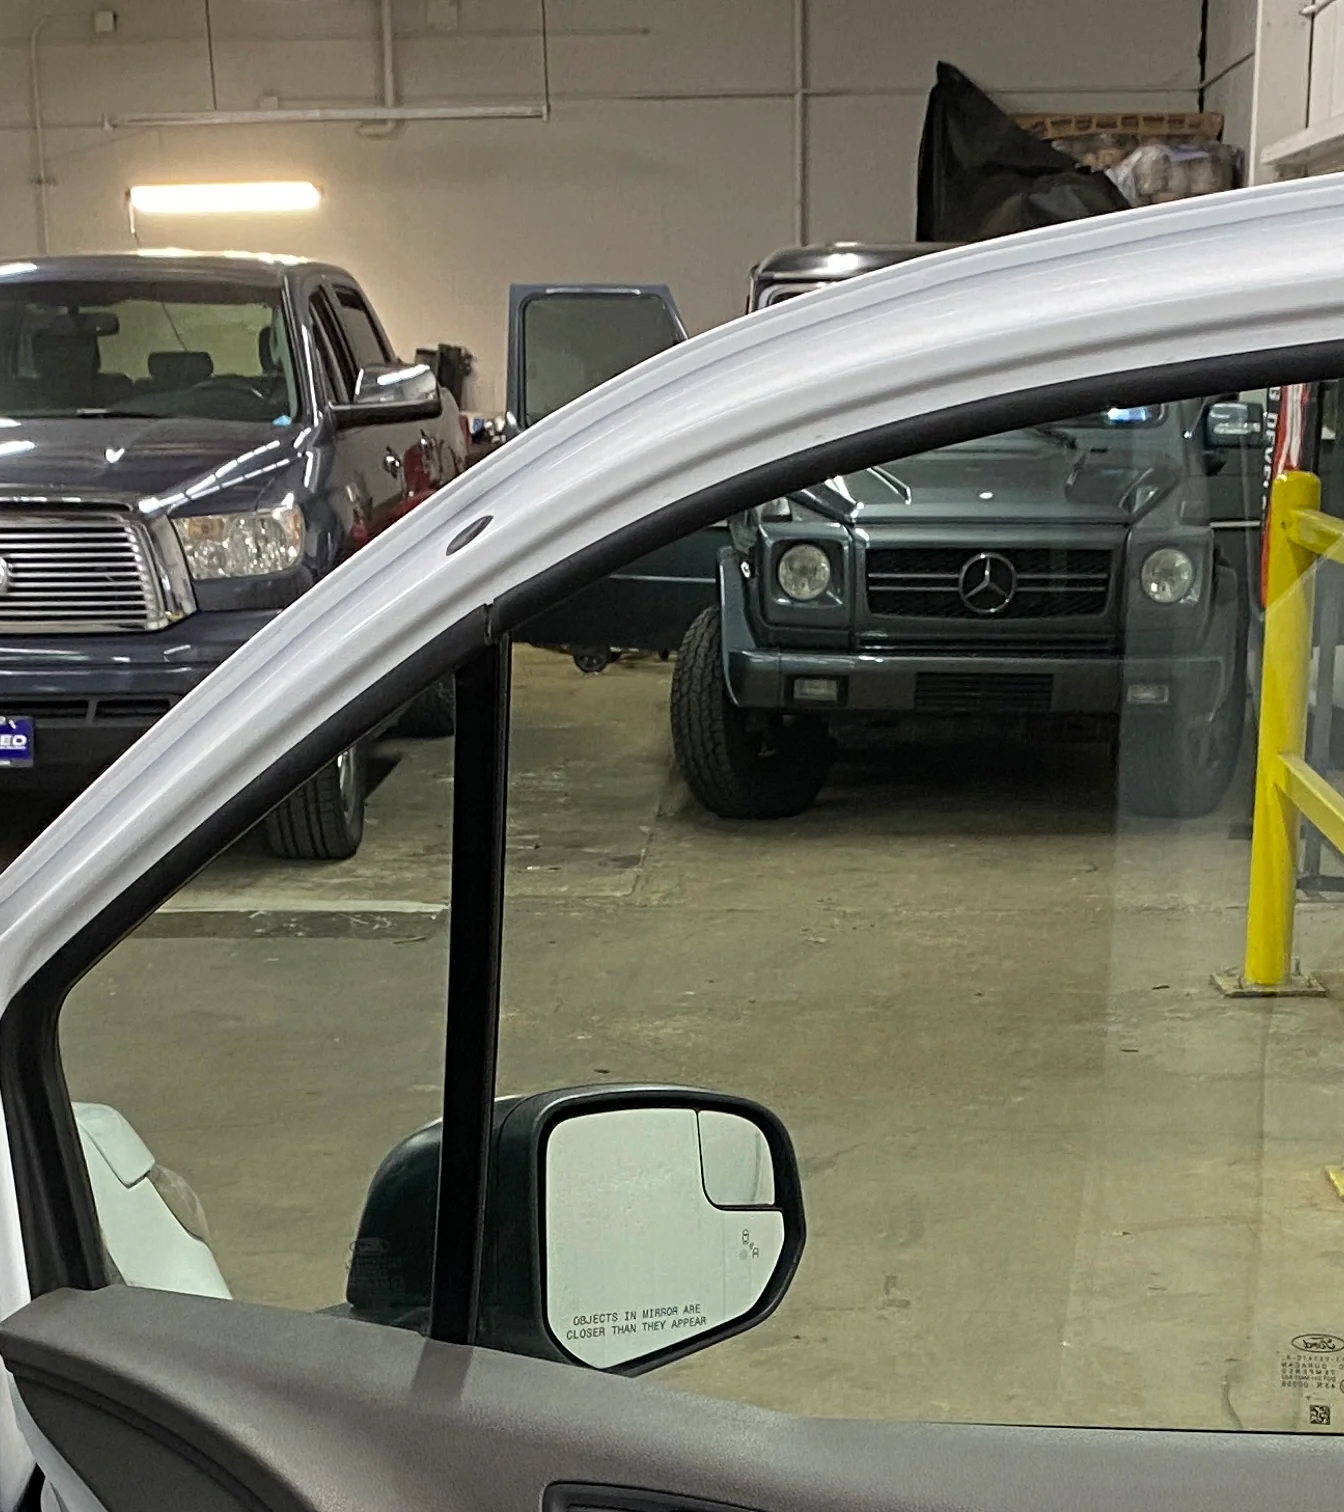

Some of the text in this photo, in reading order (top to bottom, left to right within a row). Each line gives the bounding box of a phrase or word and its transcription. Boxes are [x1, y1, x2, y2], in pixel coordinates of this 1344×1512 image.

[573, 1304, 701, 1326] OBJECTS IN MIRROR ARE
[566, 1315, 706, 1340] CLOSER THAN THEY APPEAR
